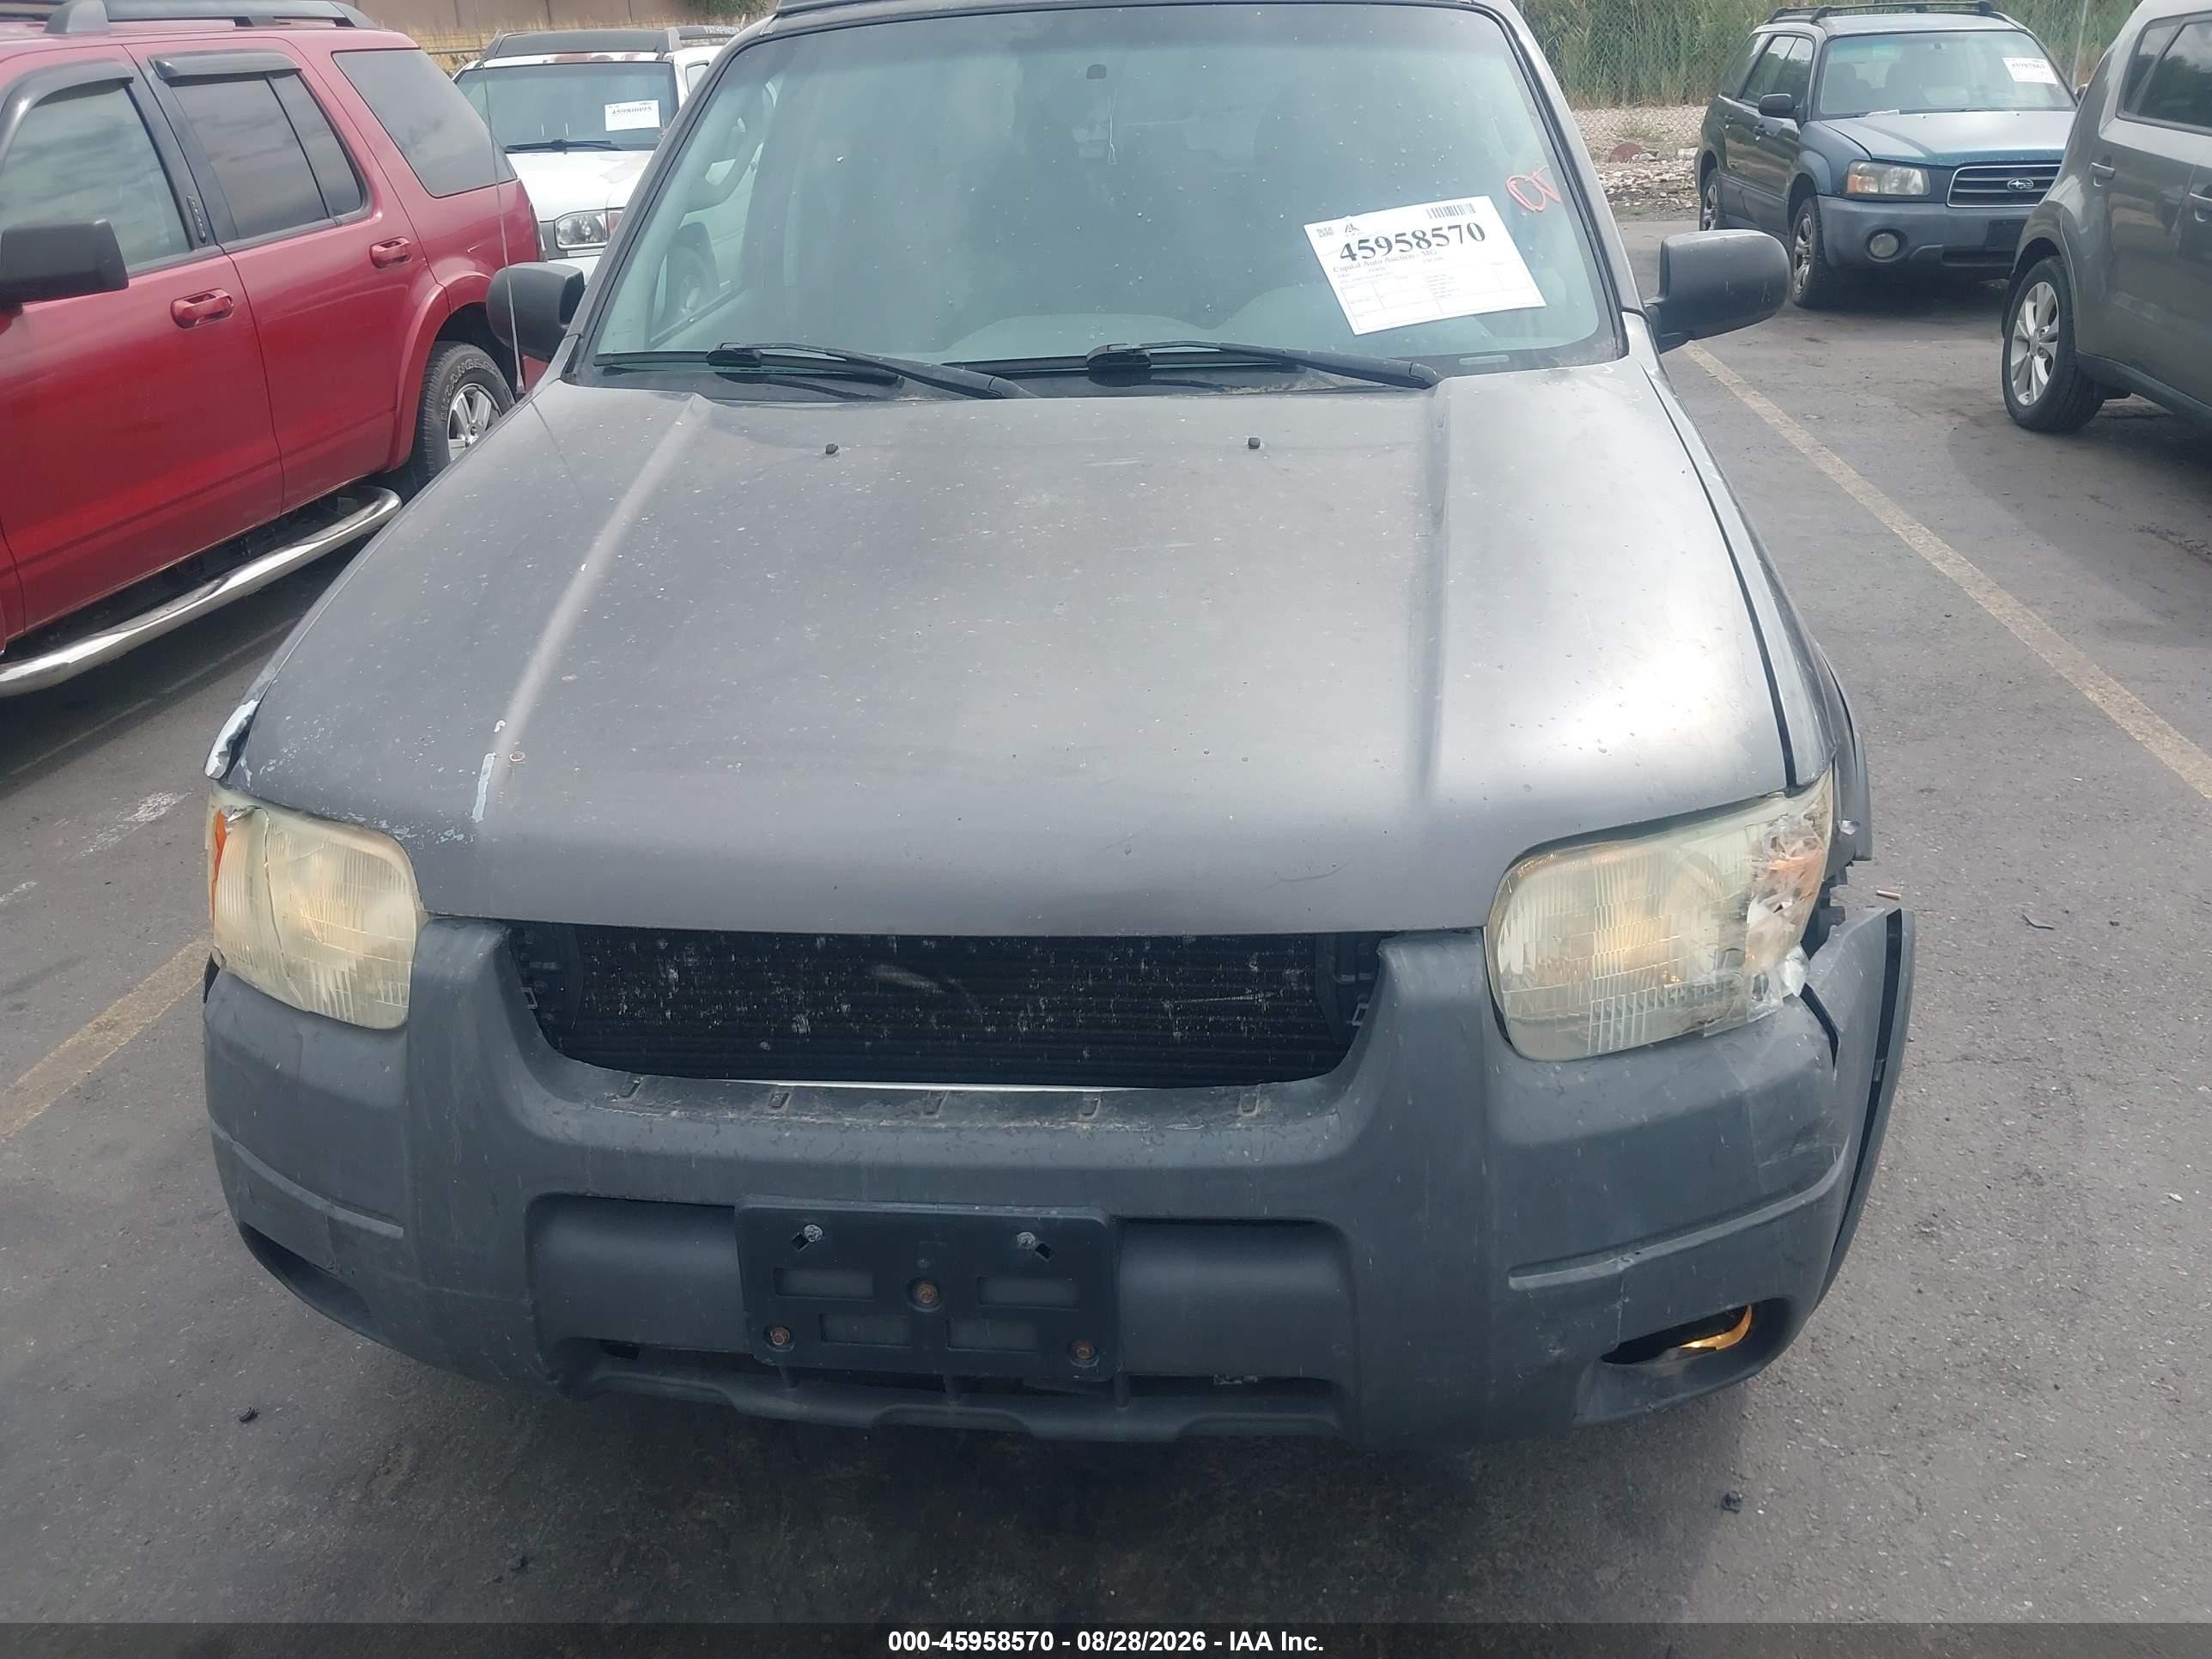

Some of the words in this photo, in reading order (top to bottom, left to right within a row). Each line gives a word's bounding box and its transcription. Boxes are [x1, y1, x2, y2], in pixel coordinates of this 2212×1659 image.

[1340, 222, 1486, 262] 45958570
[1332, 261, 1362, 273] Capital
[1364, 259, 1383, 268] Auto
[1384, 254, 1415, 264] Auction
